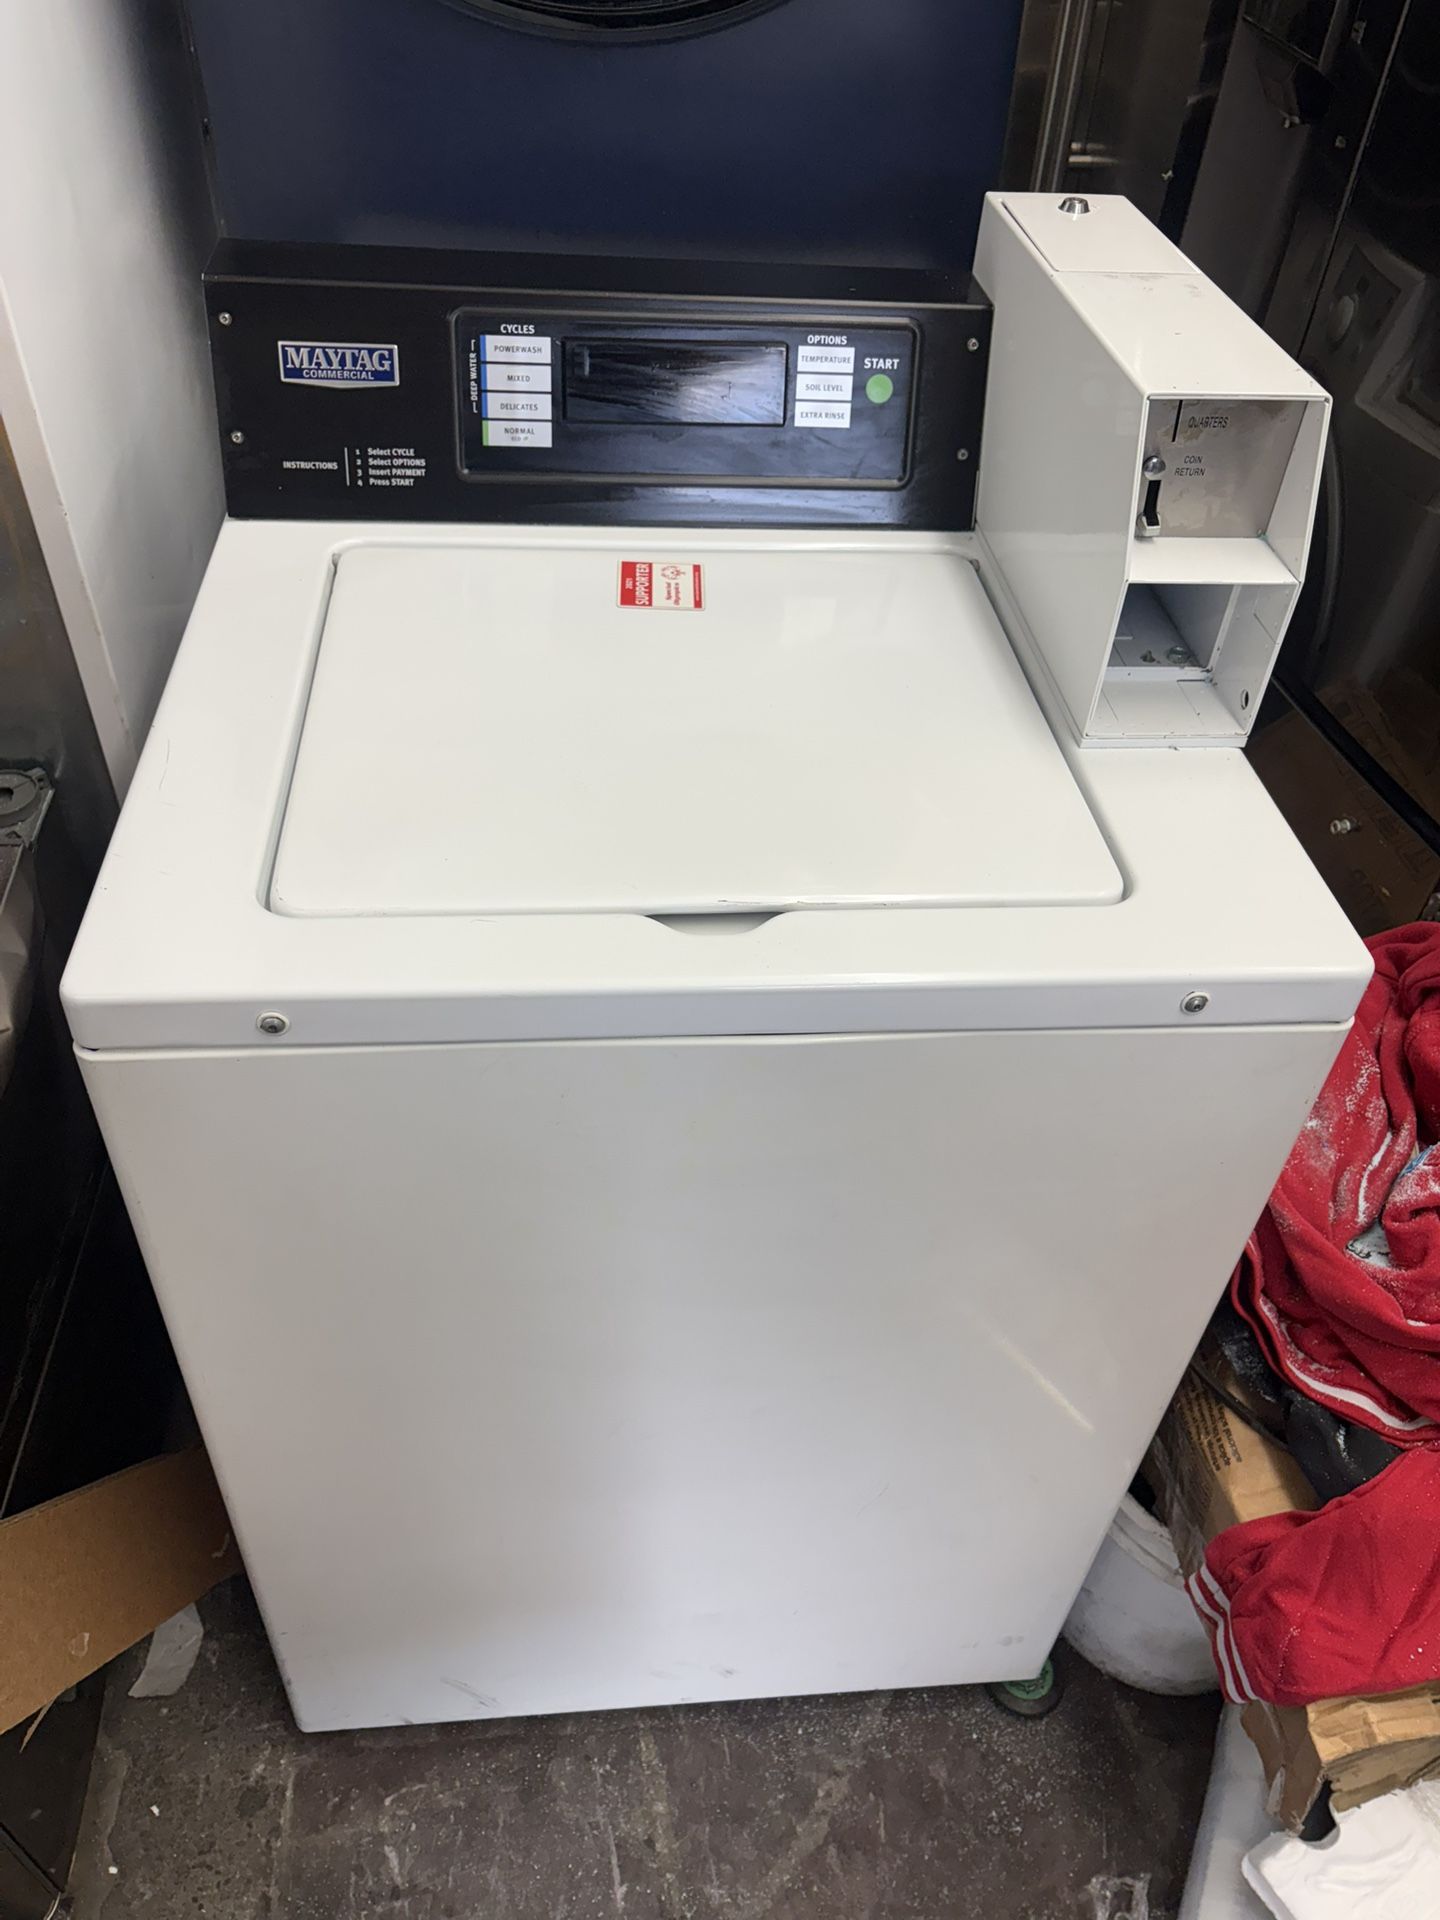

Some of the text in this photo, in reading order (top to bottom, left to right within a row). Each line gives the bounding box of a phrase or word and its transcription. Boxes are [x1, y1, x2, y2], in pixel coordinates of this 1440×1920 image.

[500, 324, 536, 334] CYCLES
[807, 335, 848, 345] OPTIONS
[494, 345, 543, 354] POWERWASH
[284, 347, 392, 372] MAYTAG
[801, 355, 851, 364] TEMPERATURE
[863, 357, 900, 370] START
[303, 369, 375, 380] COMMERCIAL
[469, 353, 478, 401] DEEP WATER
[507, 375, 531, 383] MIXED
[805, 384, 844, 392] SOIL LEVEL
[500, 402, 539, 411] DELICATES
[800, 412, 846, 420] EXTRA RINSE
[1188, 416, 1229, 429] QUARTERS
[504, 427, 535, 435] NORMAL
[367, 447, 391, 456] Select
[391, 448, 415, 457] CYCLE
[368, 458, 391, 466] Select
[392, 458, 426, 467] OPTIONS
[1184, 455, 1202, 464] COIN
[282, 461, 338, 470] INSTRUCTIONS
[368, 468, 391, 476] Insert
[392, 468, 426, 477] PAYMENT
[1174, 467, 1206, 477] RETURN
[369, 478, 390, 486] Press
[391, 478, 415, 486] START
[635, 562, 650, 605] SUPPORTER
